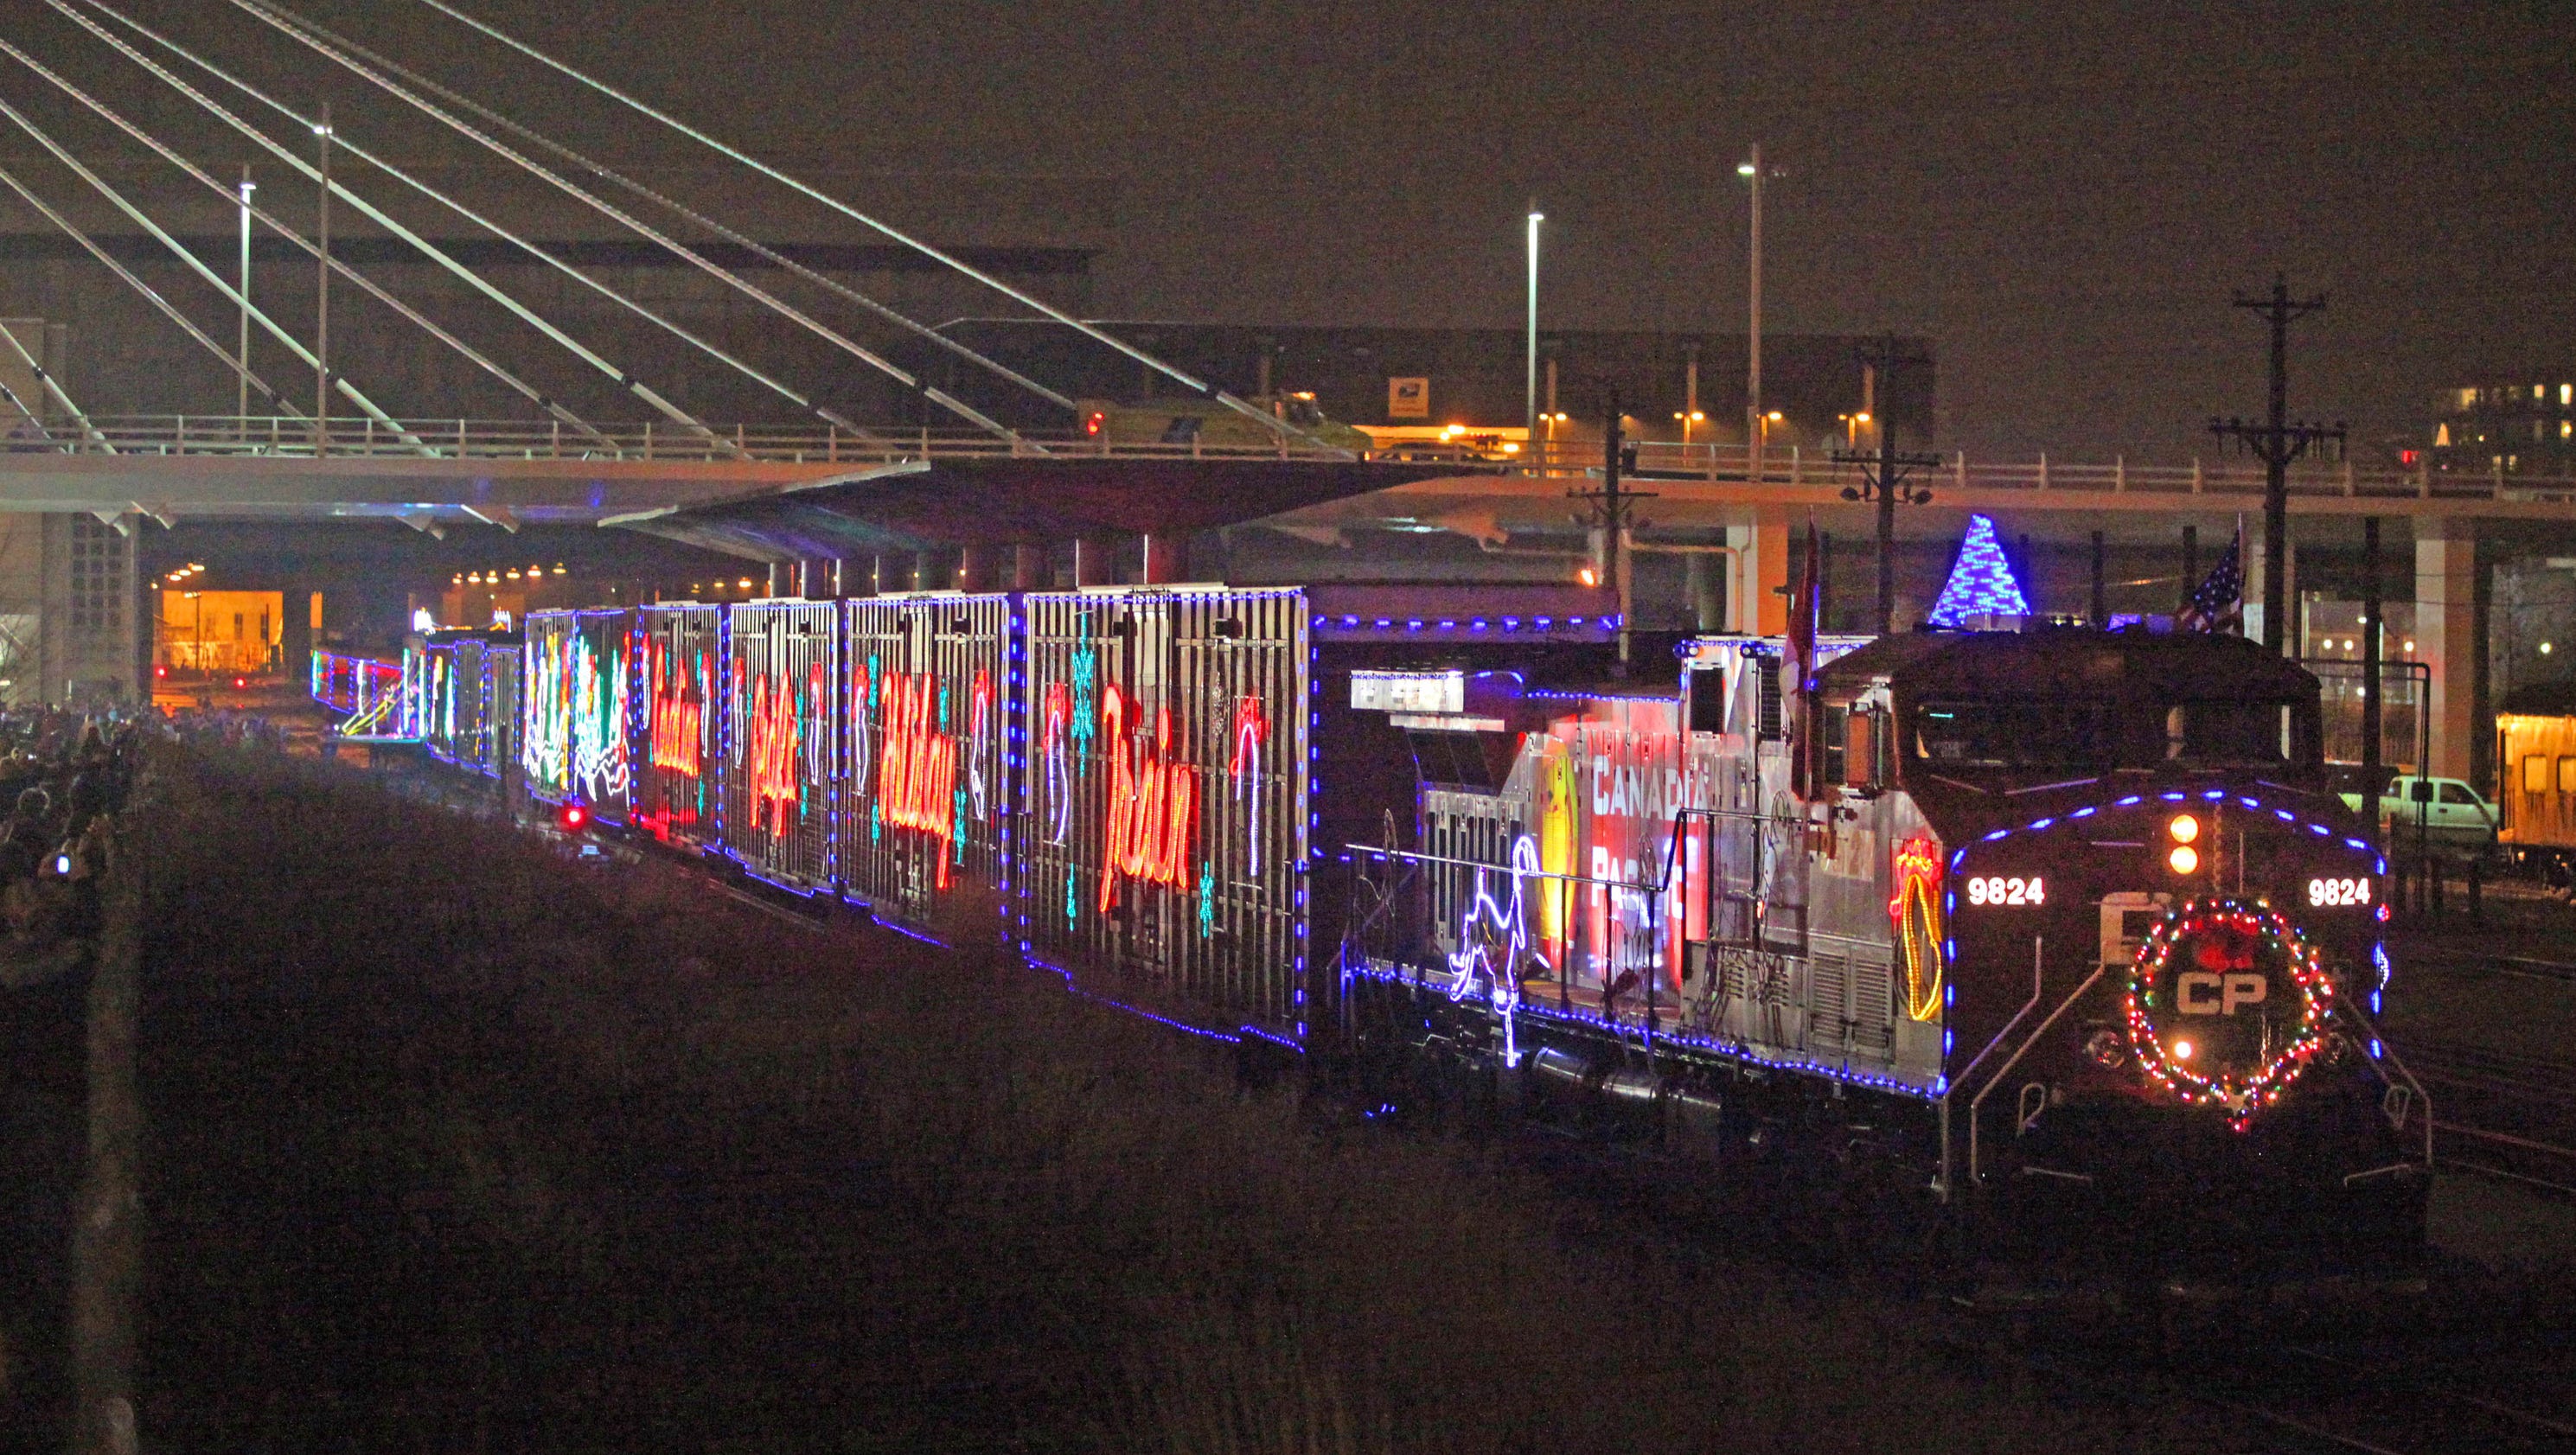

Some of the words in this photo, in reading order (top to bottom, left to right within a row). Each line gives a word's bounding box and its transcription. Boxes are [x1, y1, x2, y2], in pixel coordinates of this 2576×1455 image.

[879, 673, 955, 889] Holiday
[1099, 686, 1191, 912] Train
[1968, 877, 2045, 905] 9824
[2309, 877, 2370, 906] 9824
[2177, 972, 2267, 1015] CP
